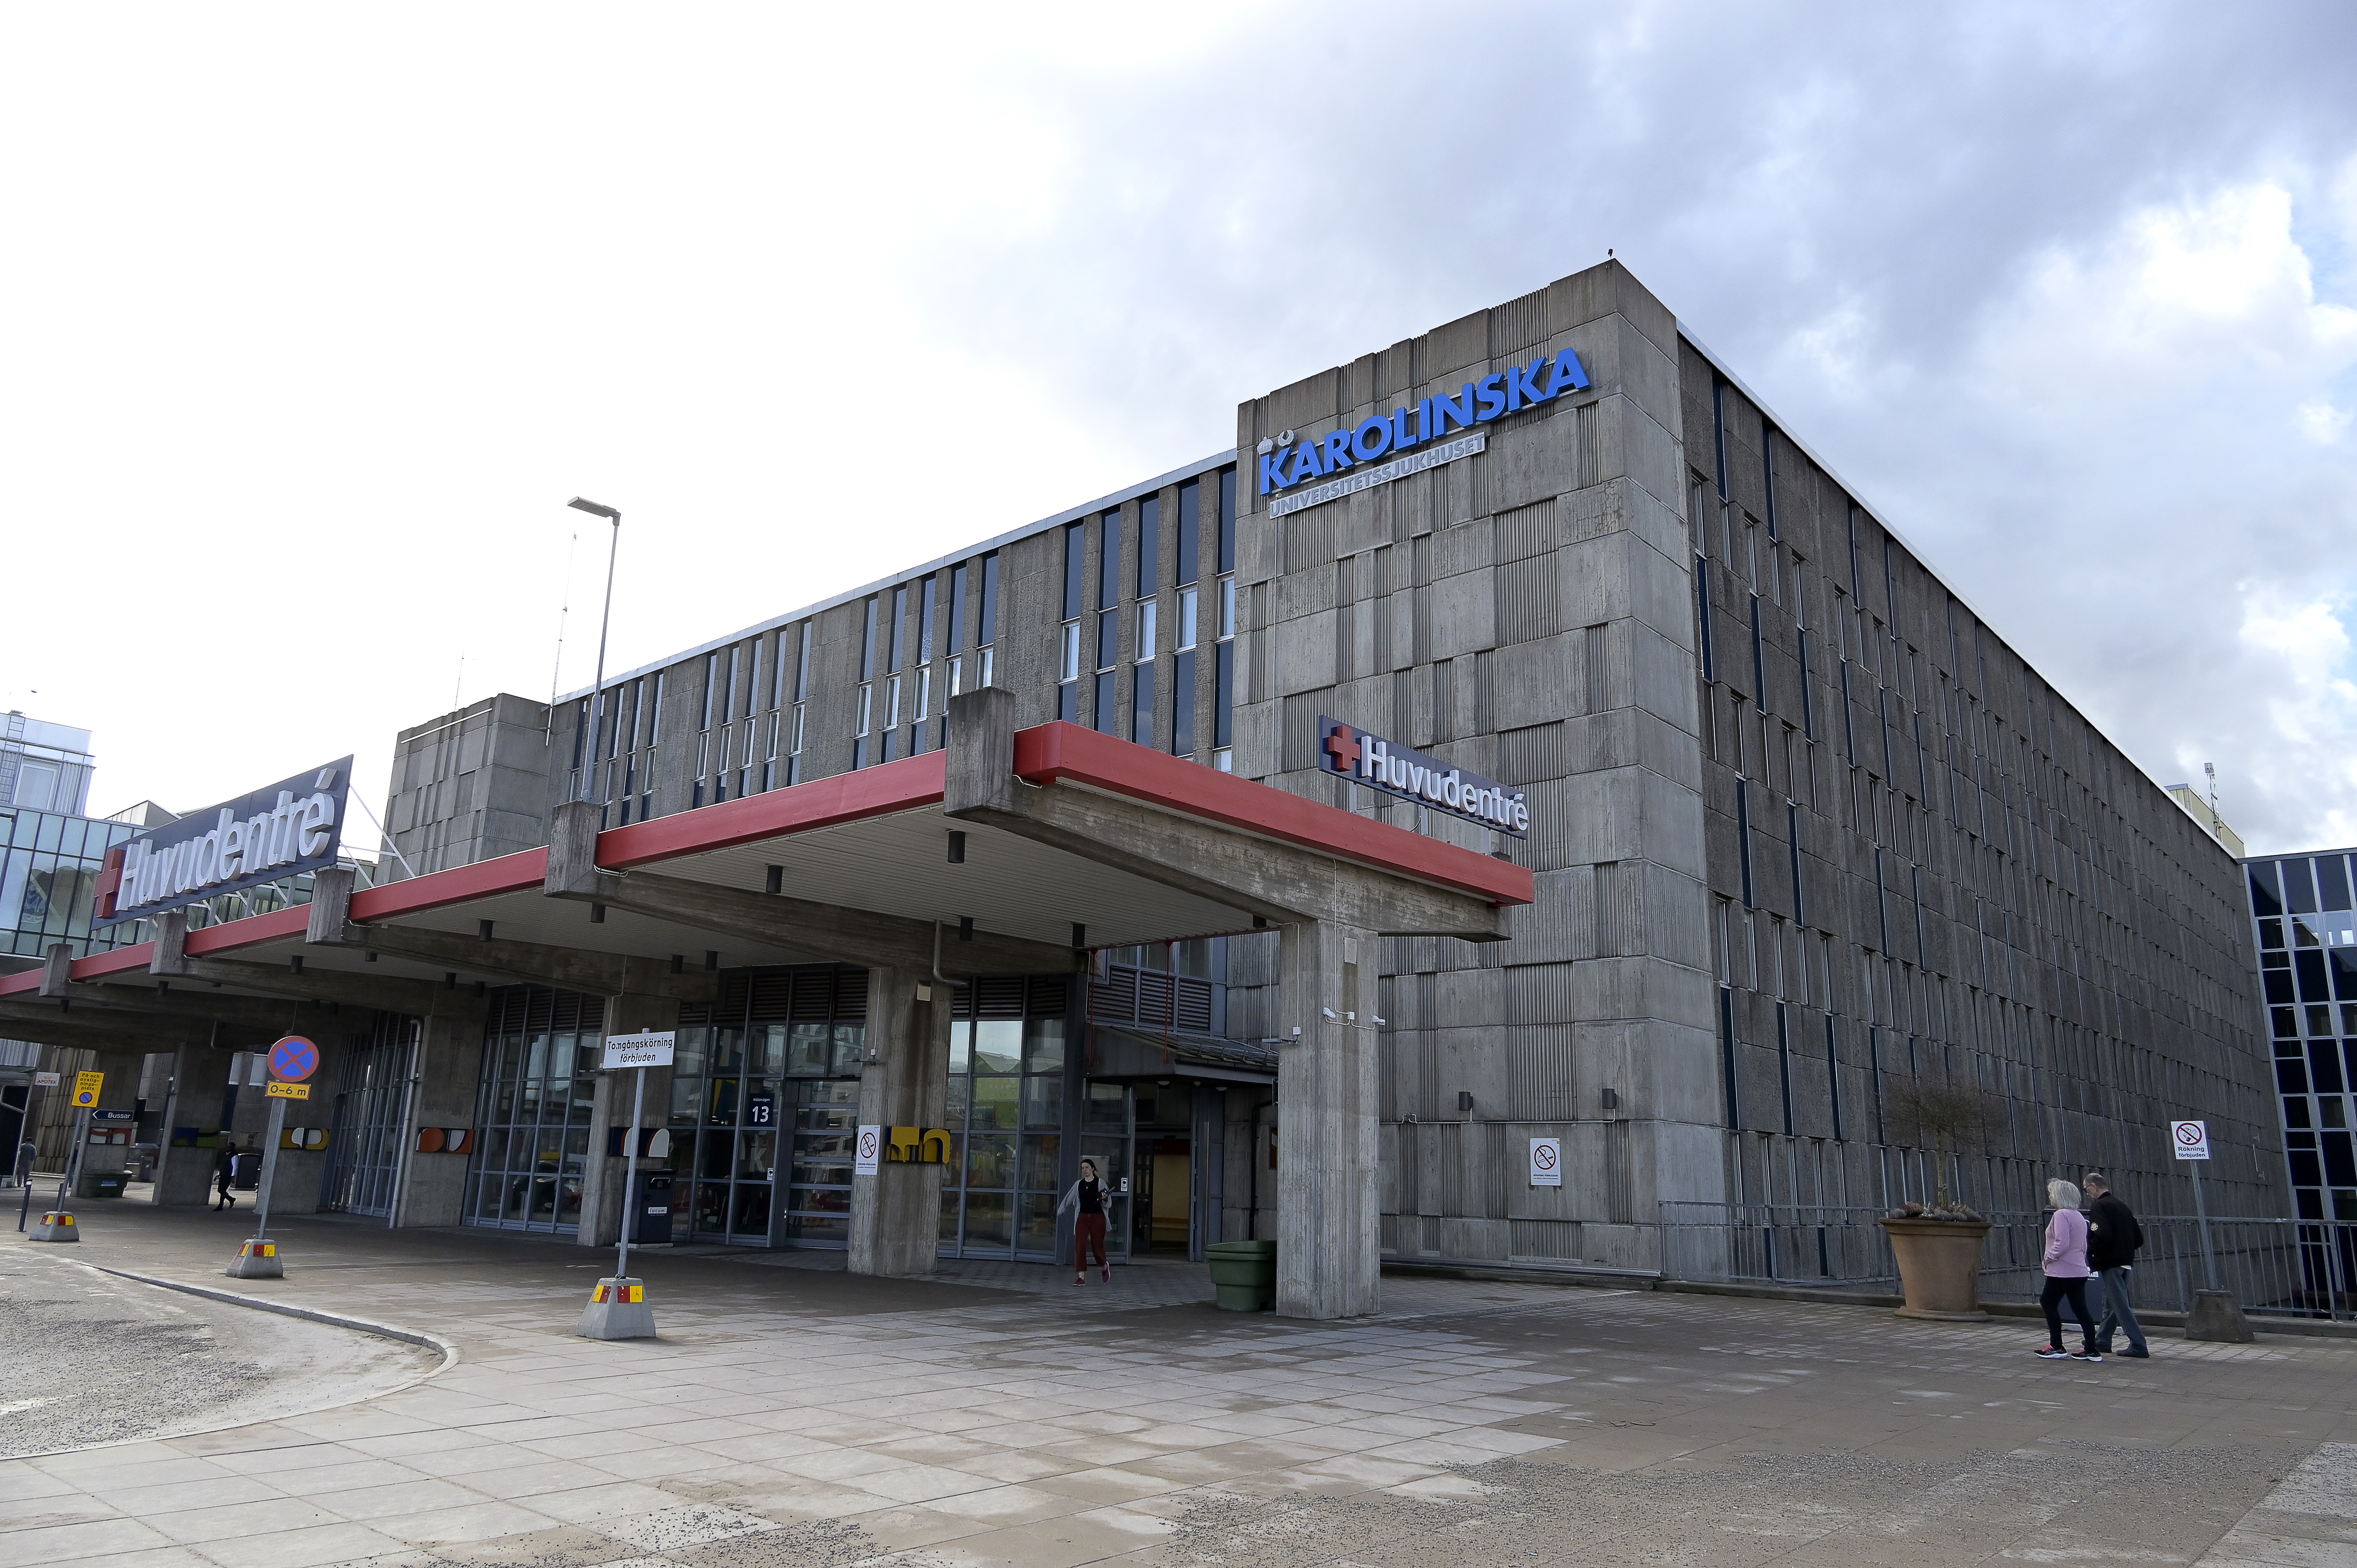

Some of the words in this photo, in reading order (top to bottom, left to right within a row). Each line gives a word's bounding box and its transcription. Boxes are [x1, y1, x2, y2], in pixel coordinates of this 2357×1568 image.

[1260, 347, 1591, 497] KAROLINSKA
[1270, 434, 1484, 517] UNIVERSITETSSJUKHUSET
[1361, 735, 1528, 831] Huvudentré
[116, 768, 335, 911] Huvudentré
[270, 1085, 293, 1095] 0-6
[620, 1052, 656, 1064] förbjuden
[753, 1106, 769, 1122] 13
